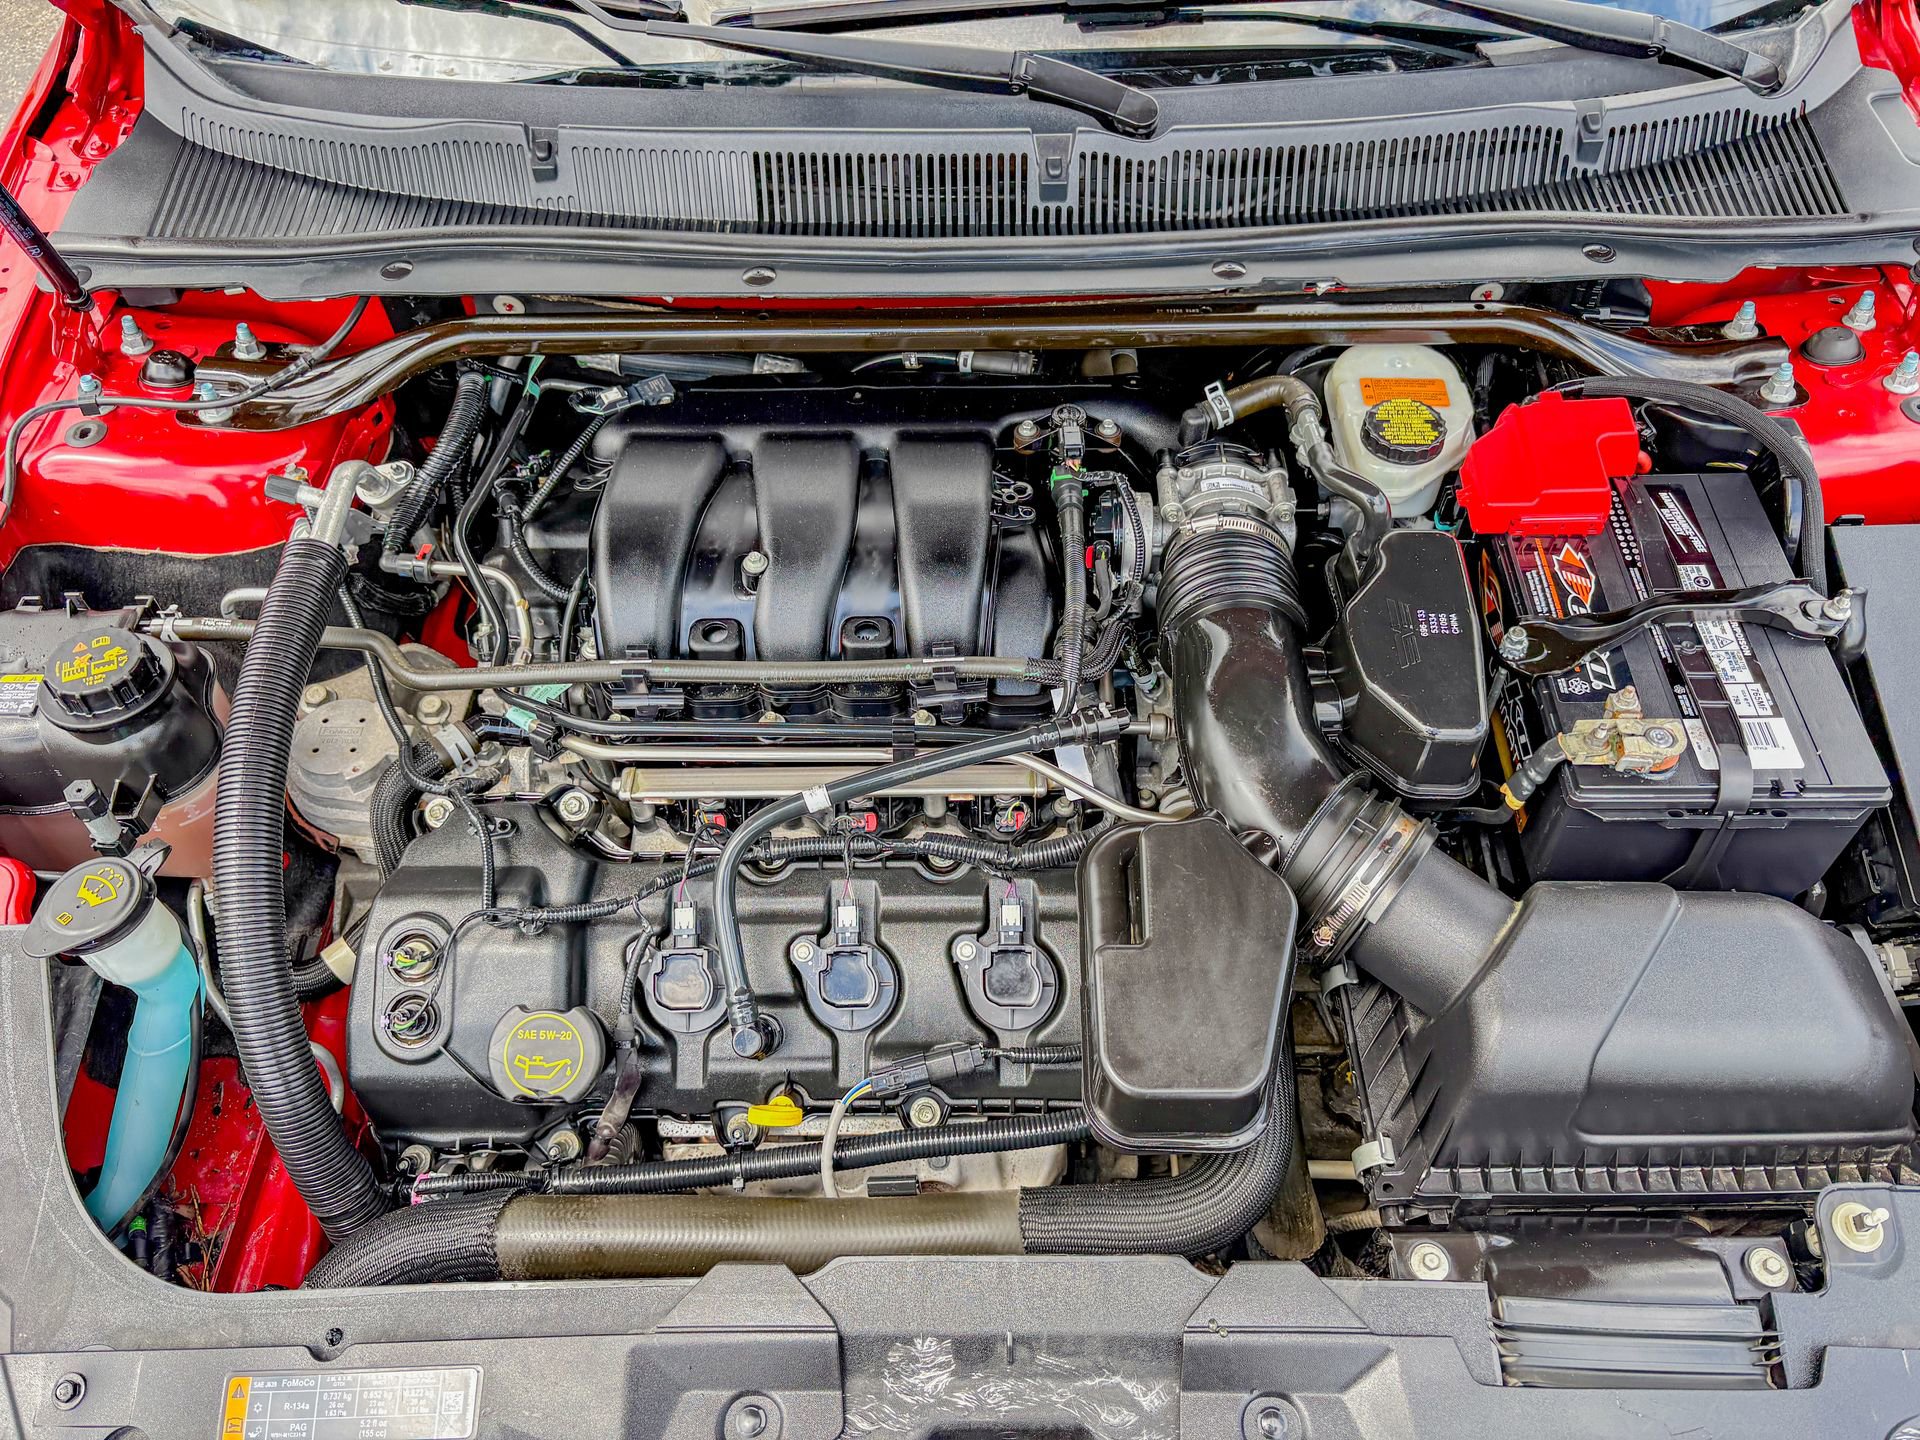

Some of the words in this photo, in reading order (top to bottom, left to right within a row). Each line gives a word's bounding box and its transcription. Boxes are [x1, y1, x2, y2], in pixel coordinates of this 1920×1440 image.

[1658, 492, 1708, 552] MAINTENANCE-FREE
[1660, 508, 1688, 536] BATTERY
[1417, 610, 1429, 636] 696-133
[1428, 614, 1439, 634] 53334
[1439, 614, 1449, 634] 21095
[1449, 614, 1460, 634] CHINA
[1732, 695, 1742, 705] 750
[1751, 688, 1768, 712] 765MF
[517, 1030, 537, 1040] SAE
[539, 1030, 572, 1040] 5W-20
[282, 1378, 315, 1388] FoMoCo
[323, 1392, 341, 1400] 0.737
[342, 1392, 352, 1402] kg
[284, 1402, 310, 1410] R-134a
[290, 1423, 307, 1431] PAG
[359, 1429, 374, 1438] (155
[375, 1428, 387, 1438] cc)
